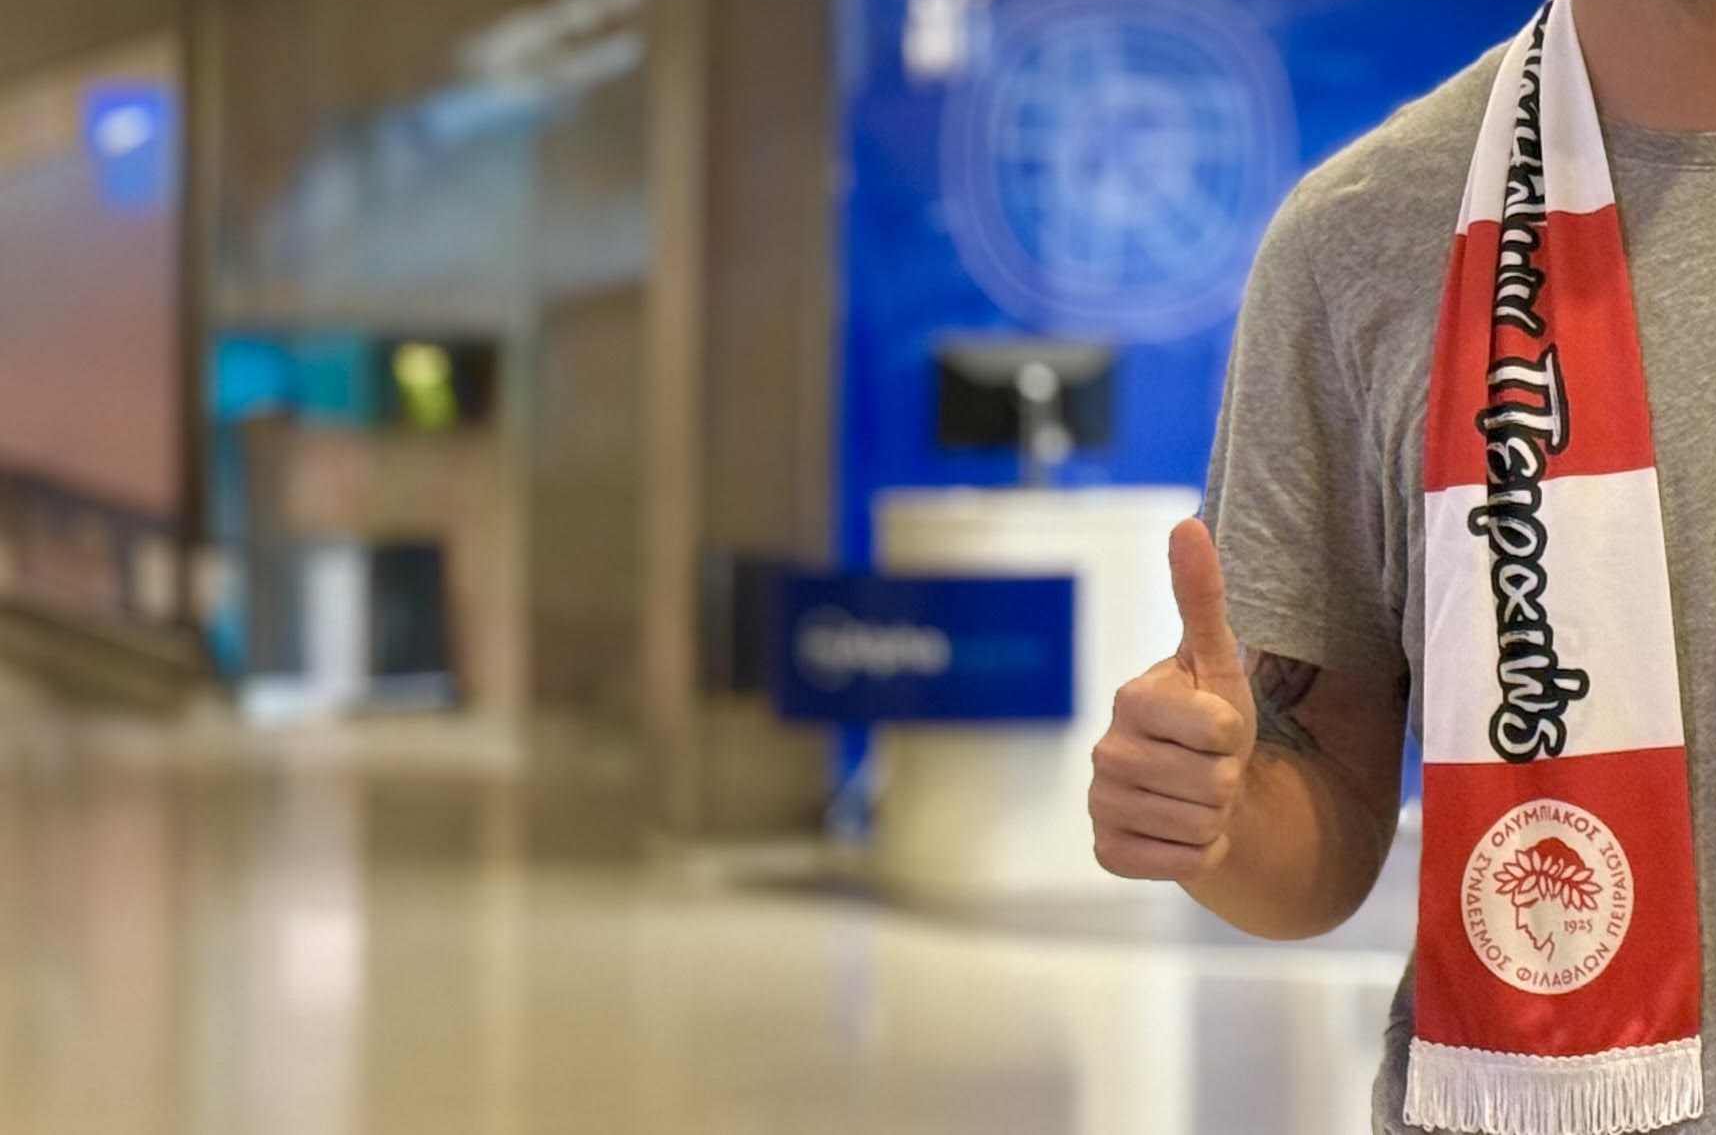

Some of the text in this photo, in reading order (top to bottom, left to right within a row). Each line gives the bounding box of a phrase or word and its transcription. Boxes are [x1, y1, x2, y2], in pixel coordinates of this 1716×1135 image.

[1491, 805, 1602, 848] ΟΛΥΜΠΙΑΚΟΣ
[1466, 852, 1513, 972] ΣΥΝΔΕΣΜΟΣ
[1516, 942, 1611, 987] ΦΙΛΑΘΛΩΝ
[1563, 918, 1594, 935] 1925
